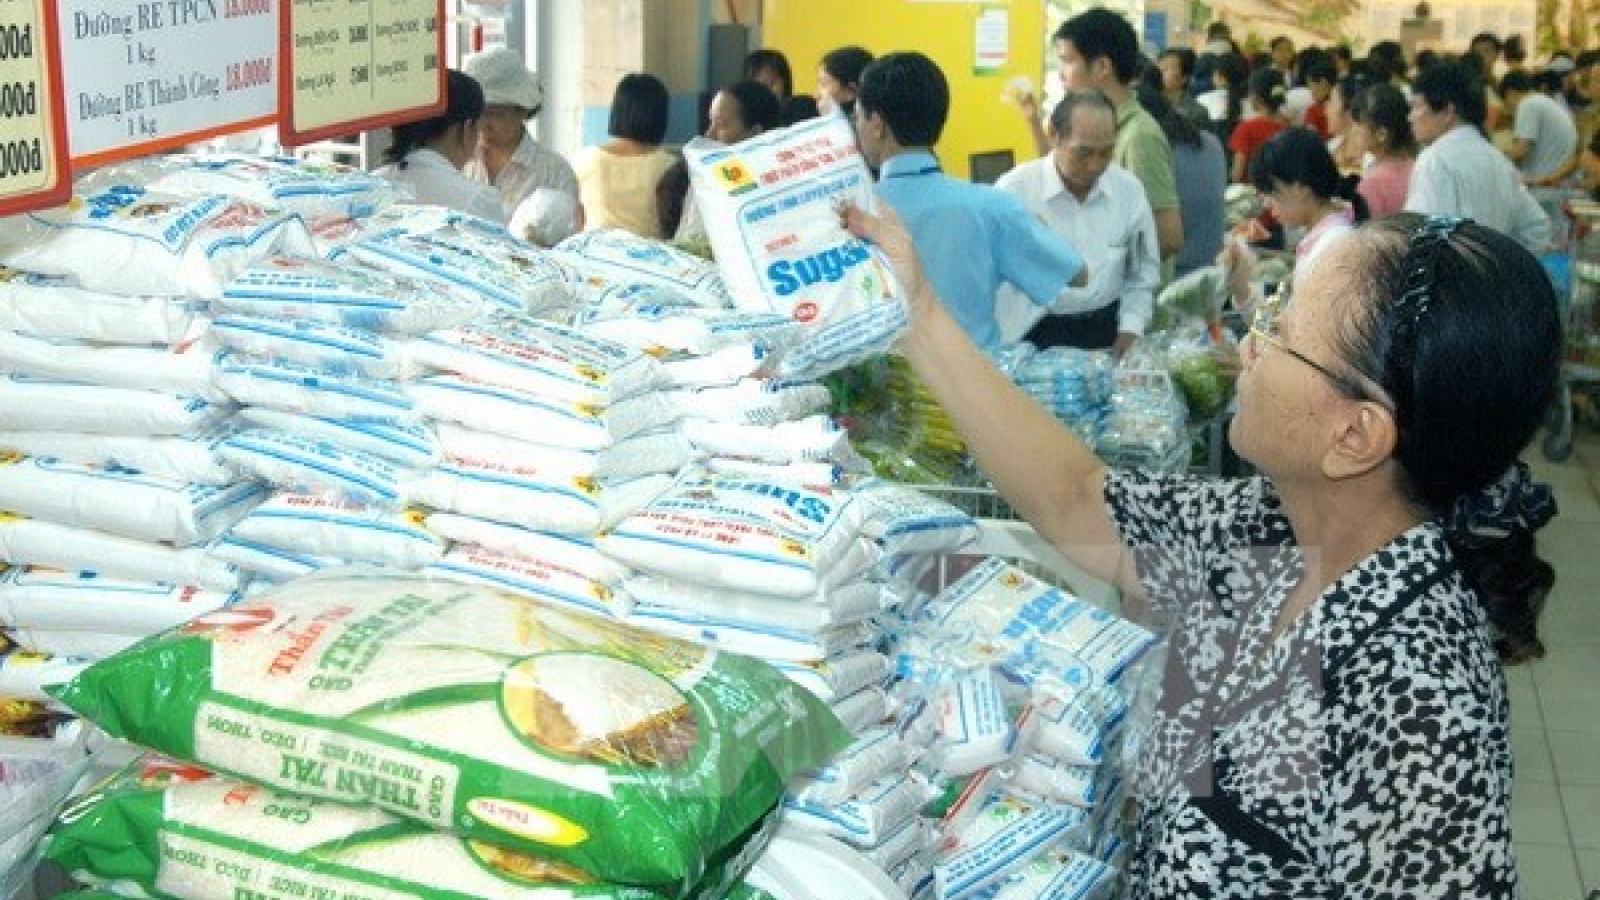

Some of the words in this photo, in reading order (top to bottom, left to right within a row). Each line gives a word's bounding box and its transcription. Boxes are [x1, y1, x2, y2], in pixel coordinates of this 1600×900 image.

[138, 2, 163, 29] RE
[168, 0, 216, 26] TPCN
[138, 42, 155, 67] kg
[125, 82, 144, 111] RE
[138, 114, 157, 136] kg
